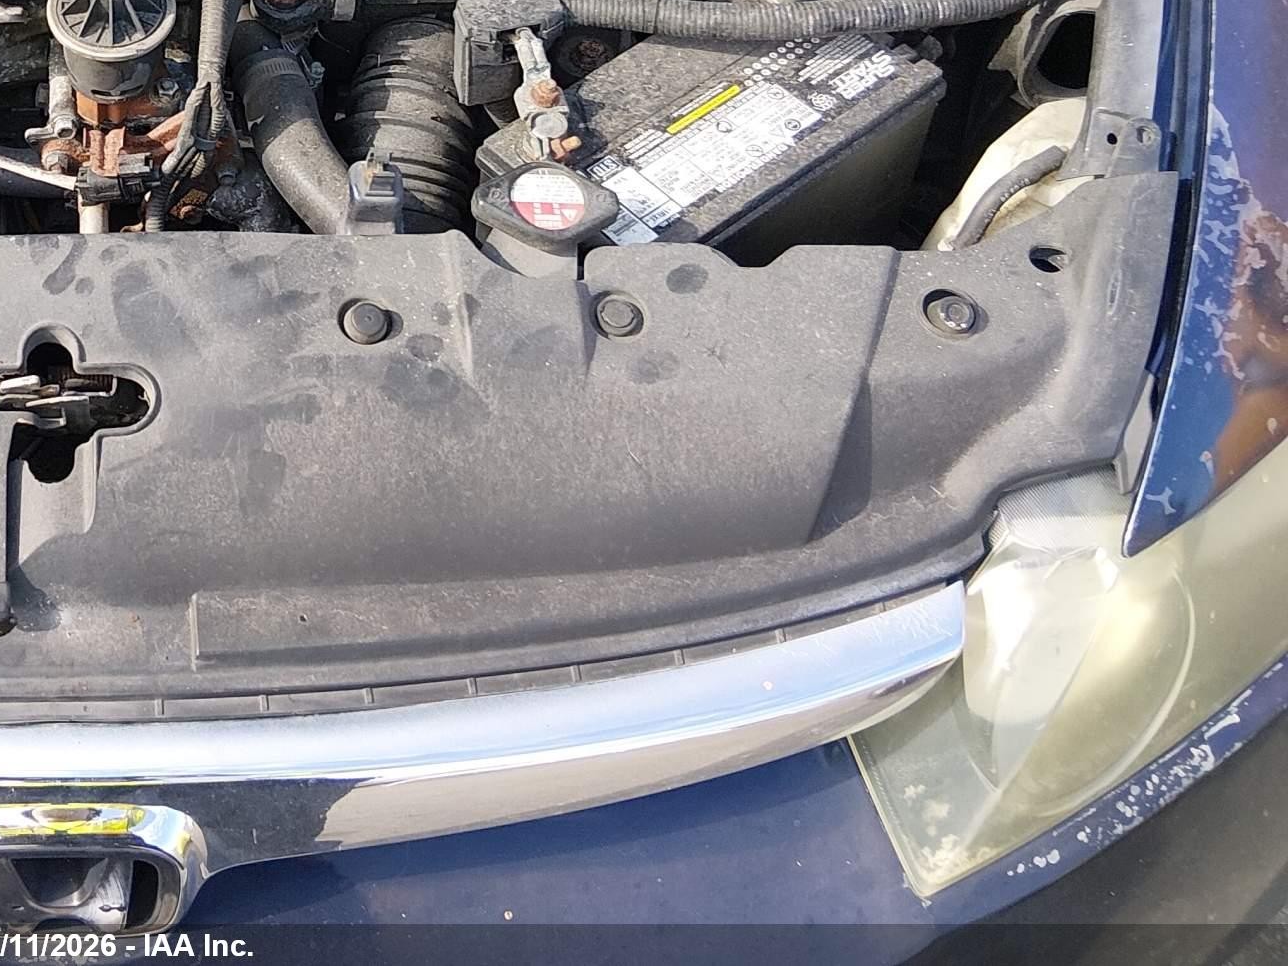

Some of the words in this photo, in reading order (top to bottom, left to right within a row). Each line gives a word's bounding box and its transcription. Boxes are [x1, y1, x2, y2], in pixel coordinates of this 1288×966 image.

[831, 49, 892, 90] START
[840, 62, 896, 101] SUPER
[591, 157, 619, 179] STD
